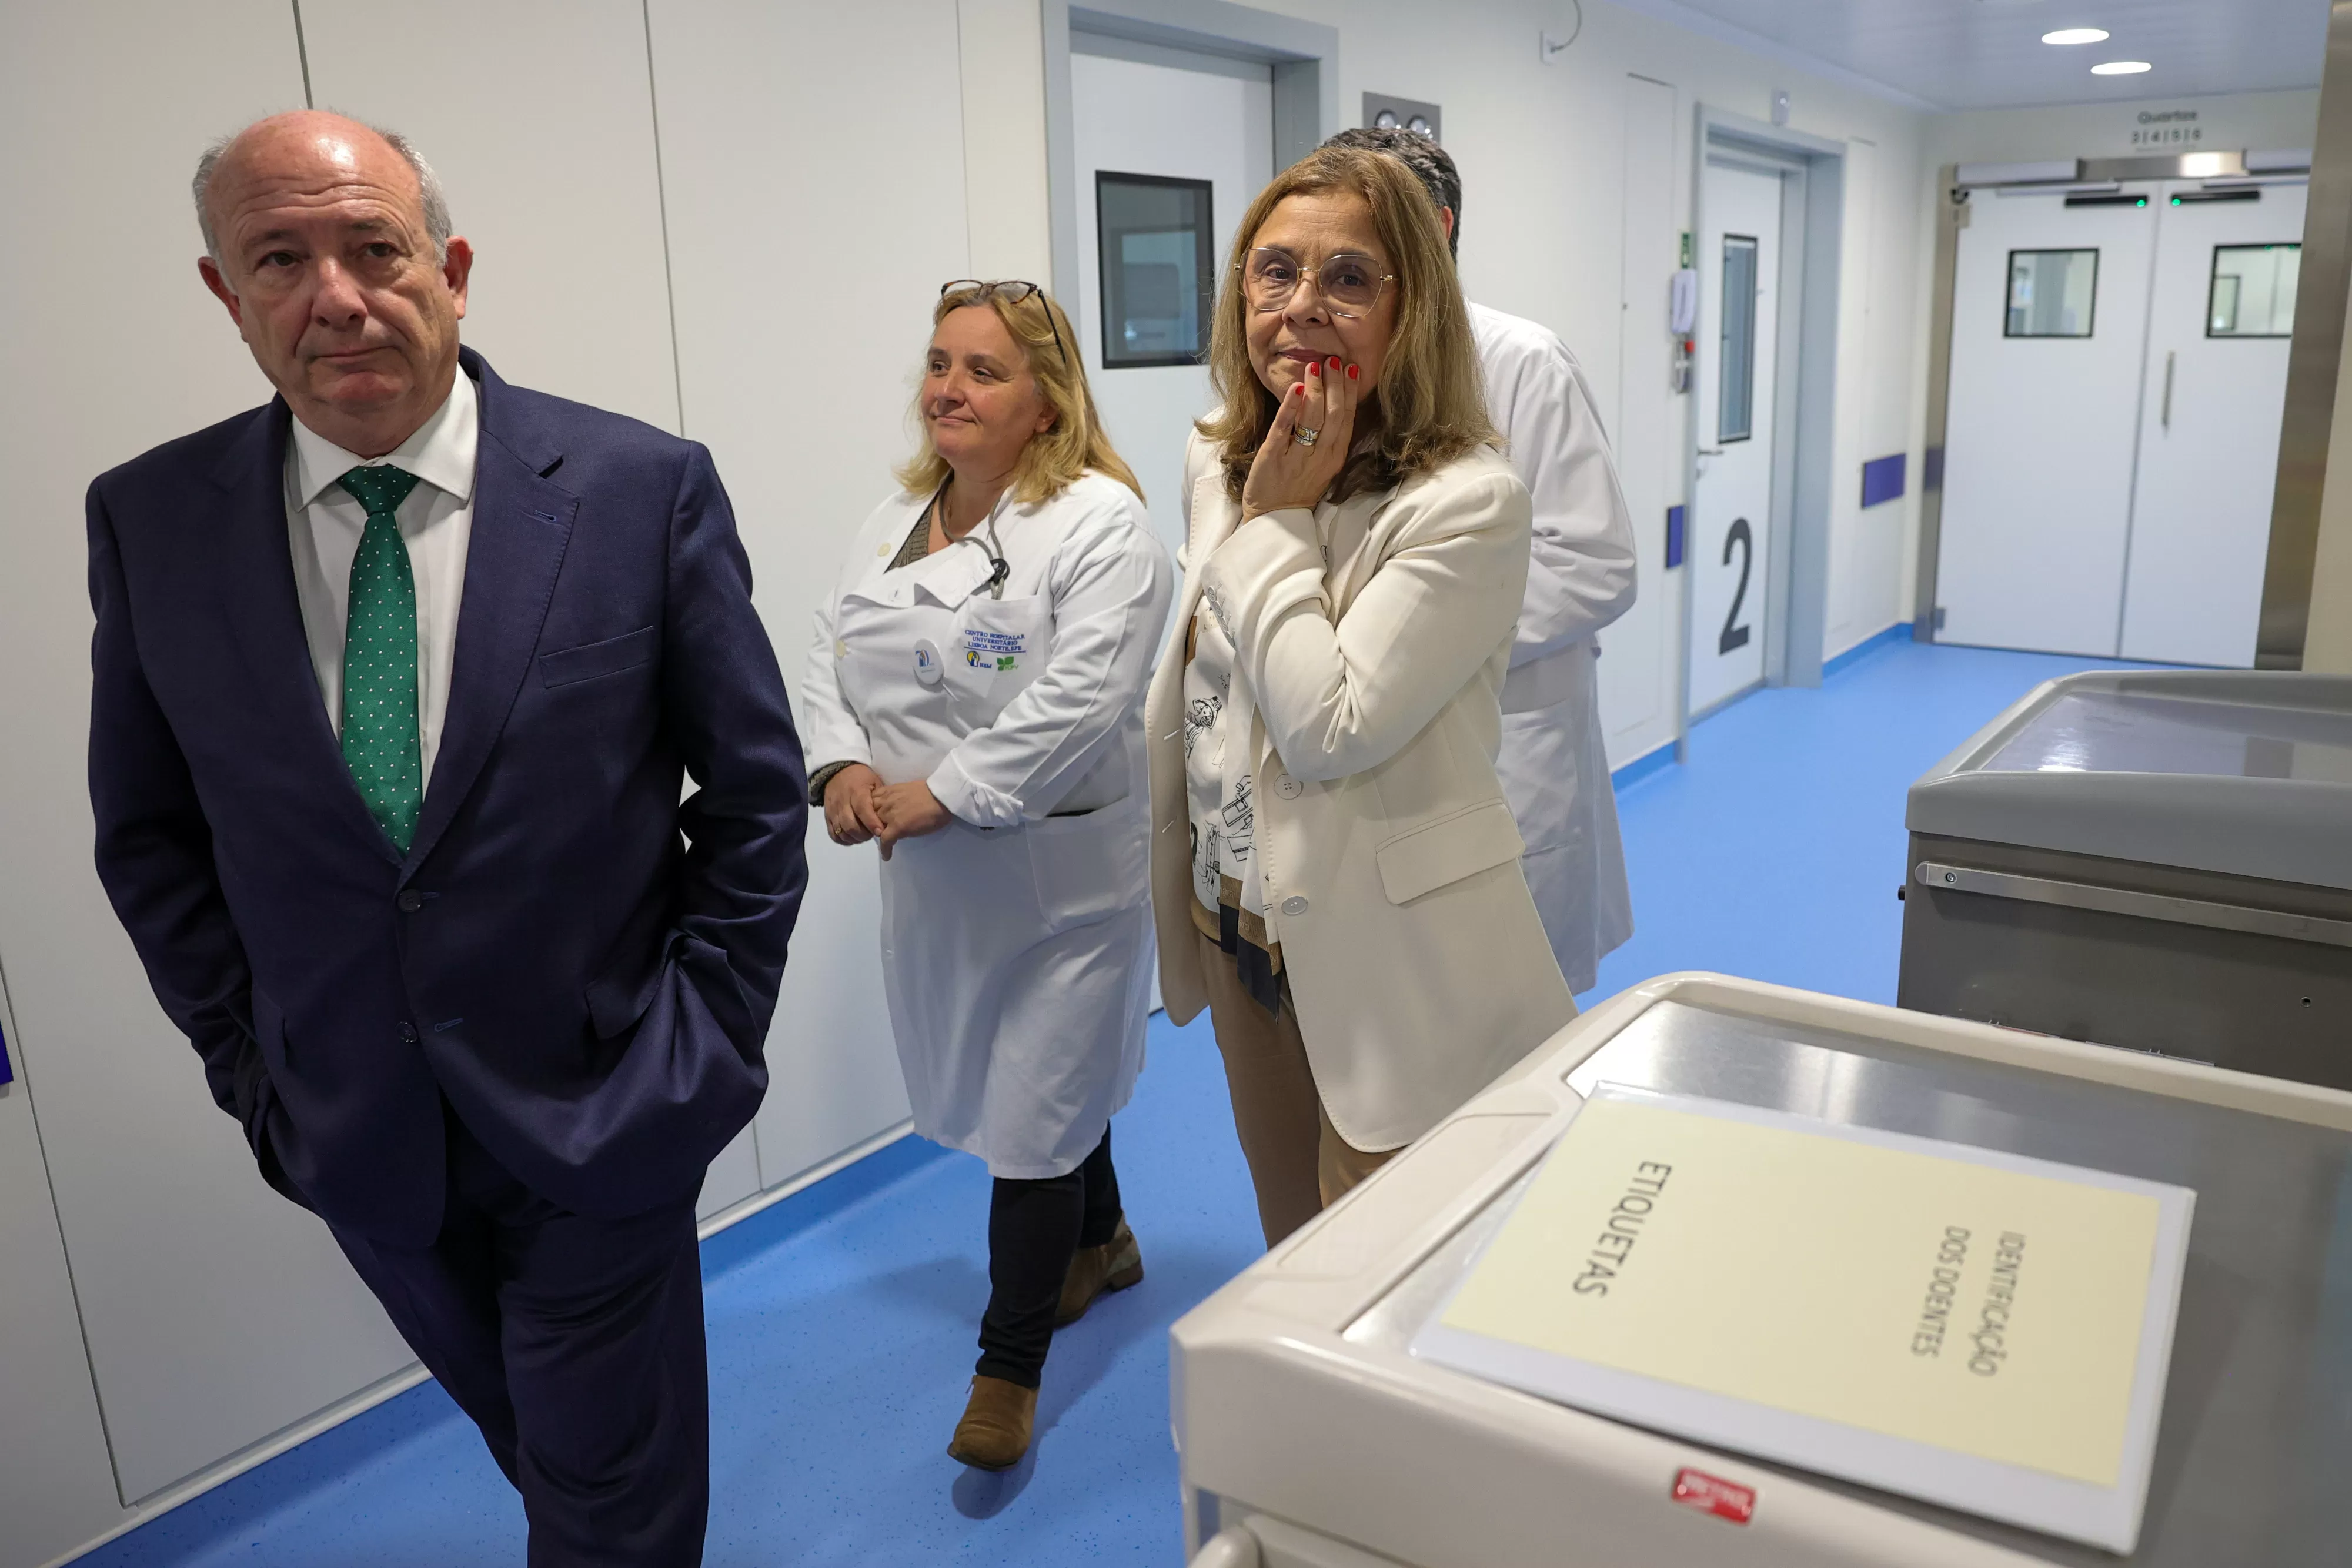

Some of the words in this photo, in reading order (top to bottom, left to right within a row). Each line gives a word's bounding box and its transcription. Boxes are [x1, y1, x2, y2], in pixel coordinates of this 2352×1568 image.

[973, 636, 1018, 646] UNIVERSITÁRIO
[1718, 516, 1753, 657] 2
[1572, 1161, 1673, 1297] ETIQUETAS
[1937, 1226, 1972, 1266] DOS
[1911, 1266, 1960, 1358] DOENTES
[1968, 1231, 2026, 1377] IDENTIFICAÇÃO
